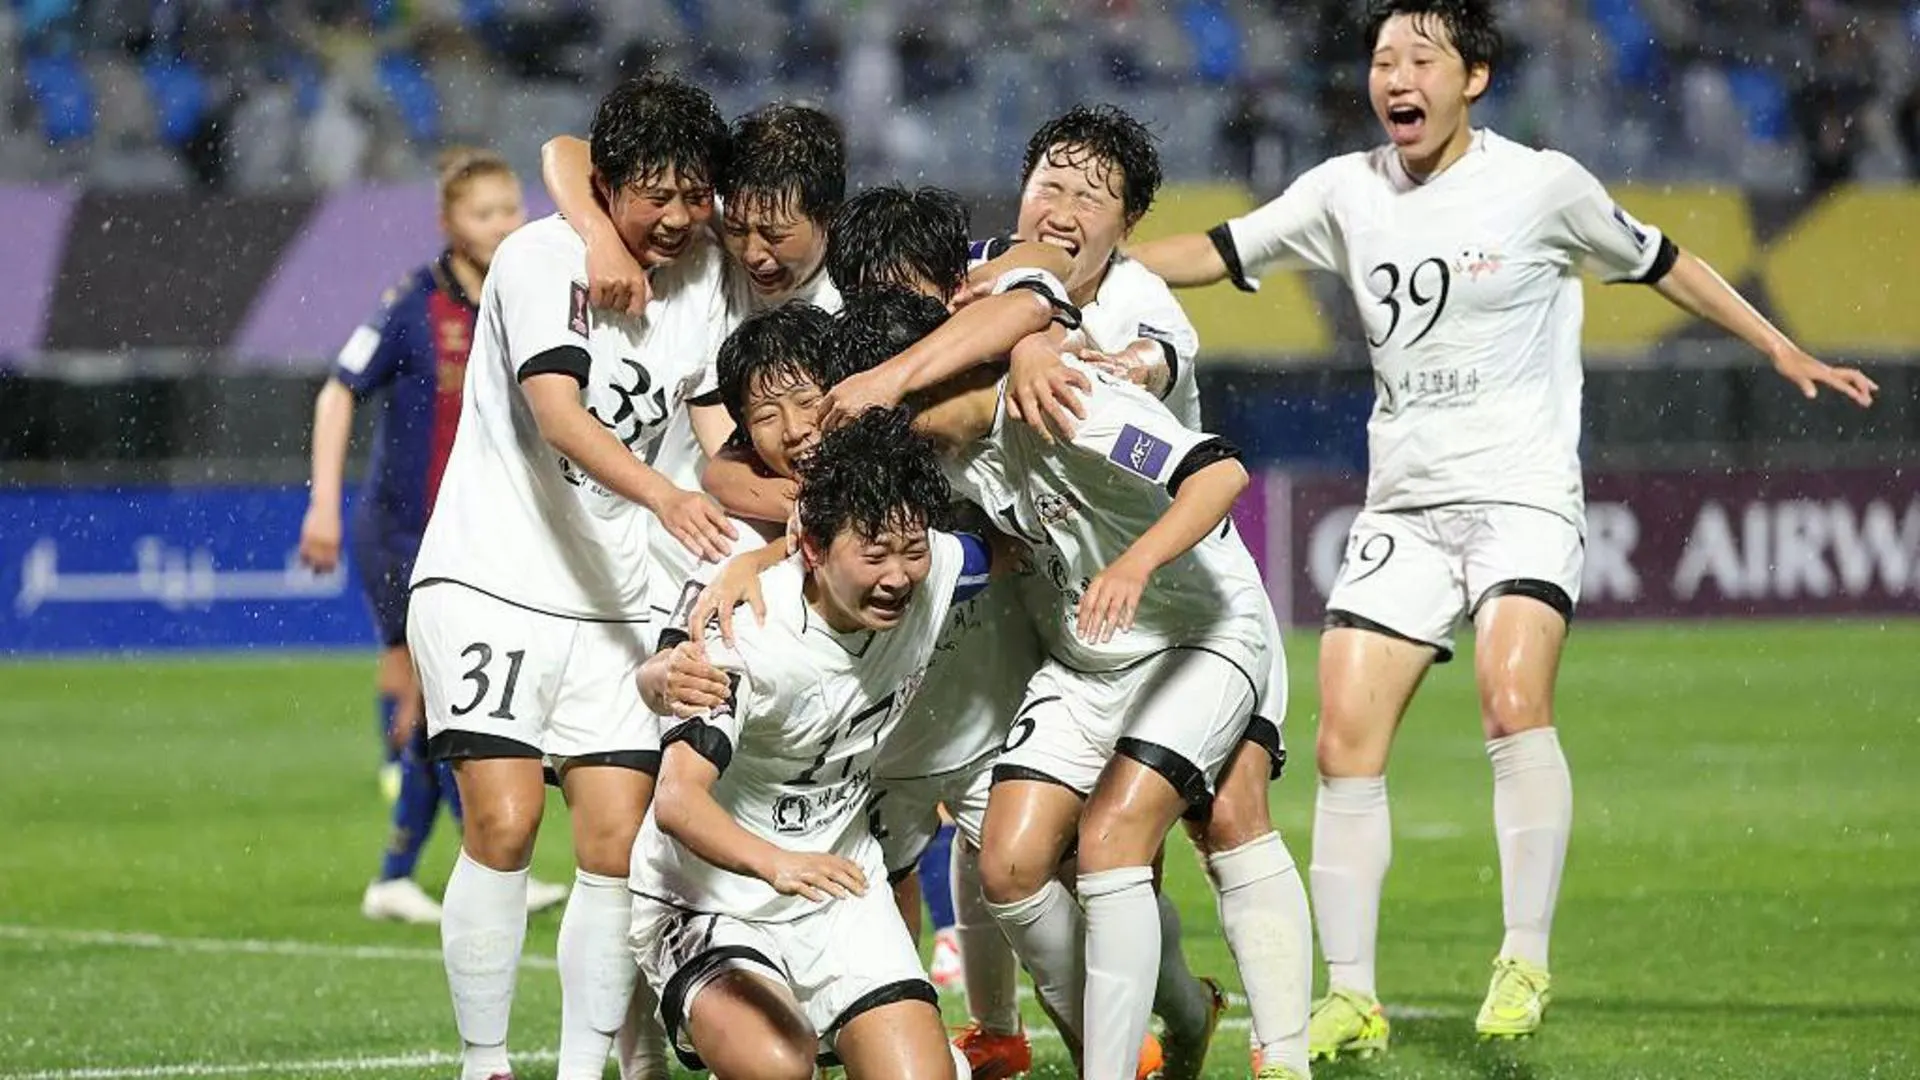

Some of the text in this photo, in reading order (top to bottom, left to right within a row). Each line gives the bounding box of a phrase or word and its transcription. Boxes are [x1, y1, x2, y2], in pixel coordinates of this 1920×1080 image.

[1367, 257, 1450, 350] 39
[1343, 532, 1395, 586] 9
[1673, 500, 1920, 600] AIRW
[451, 642, 525, 720] 31
[782, 691, 896, 786] 17
